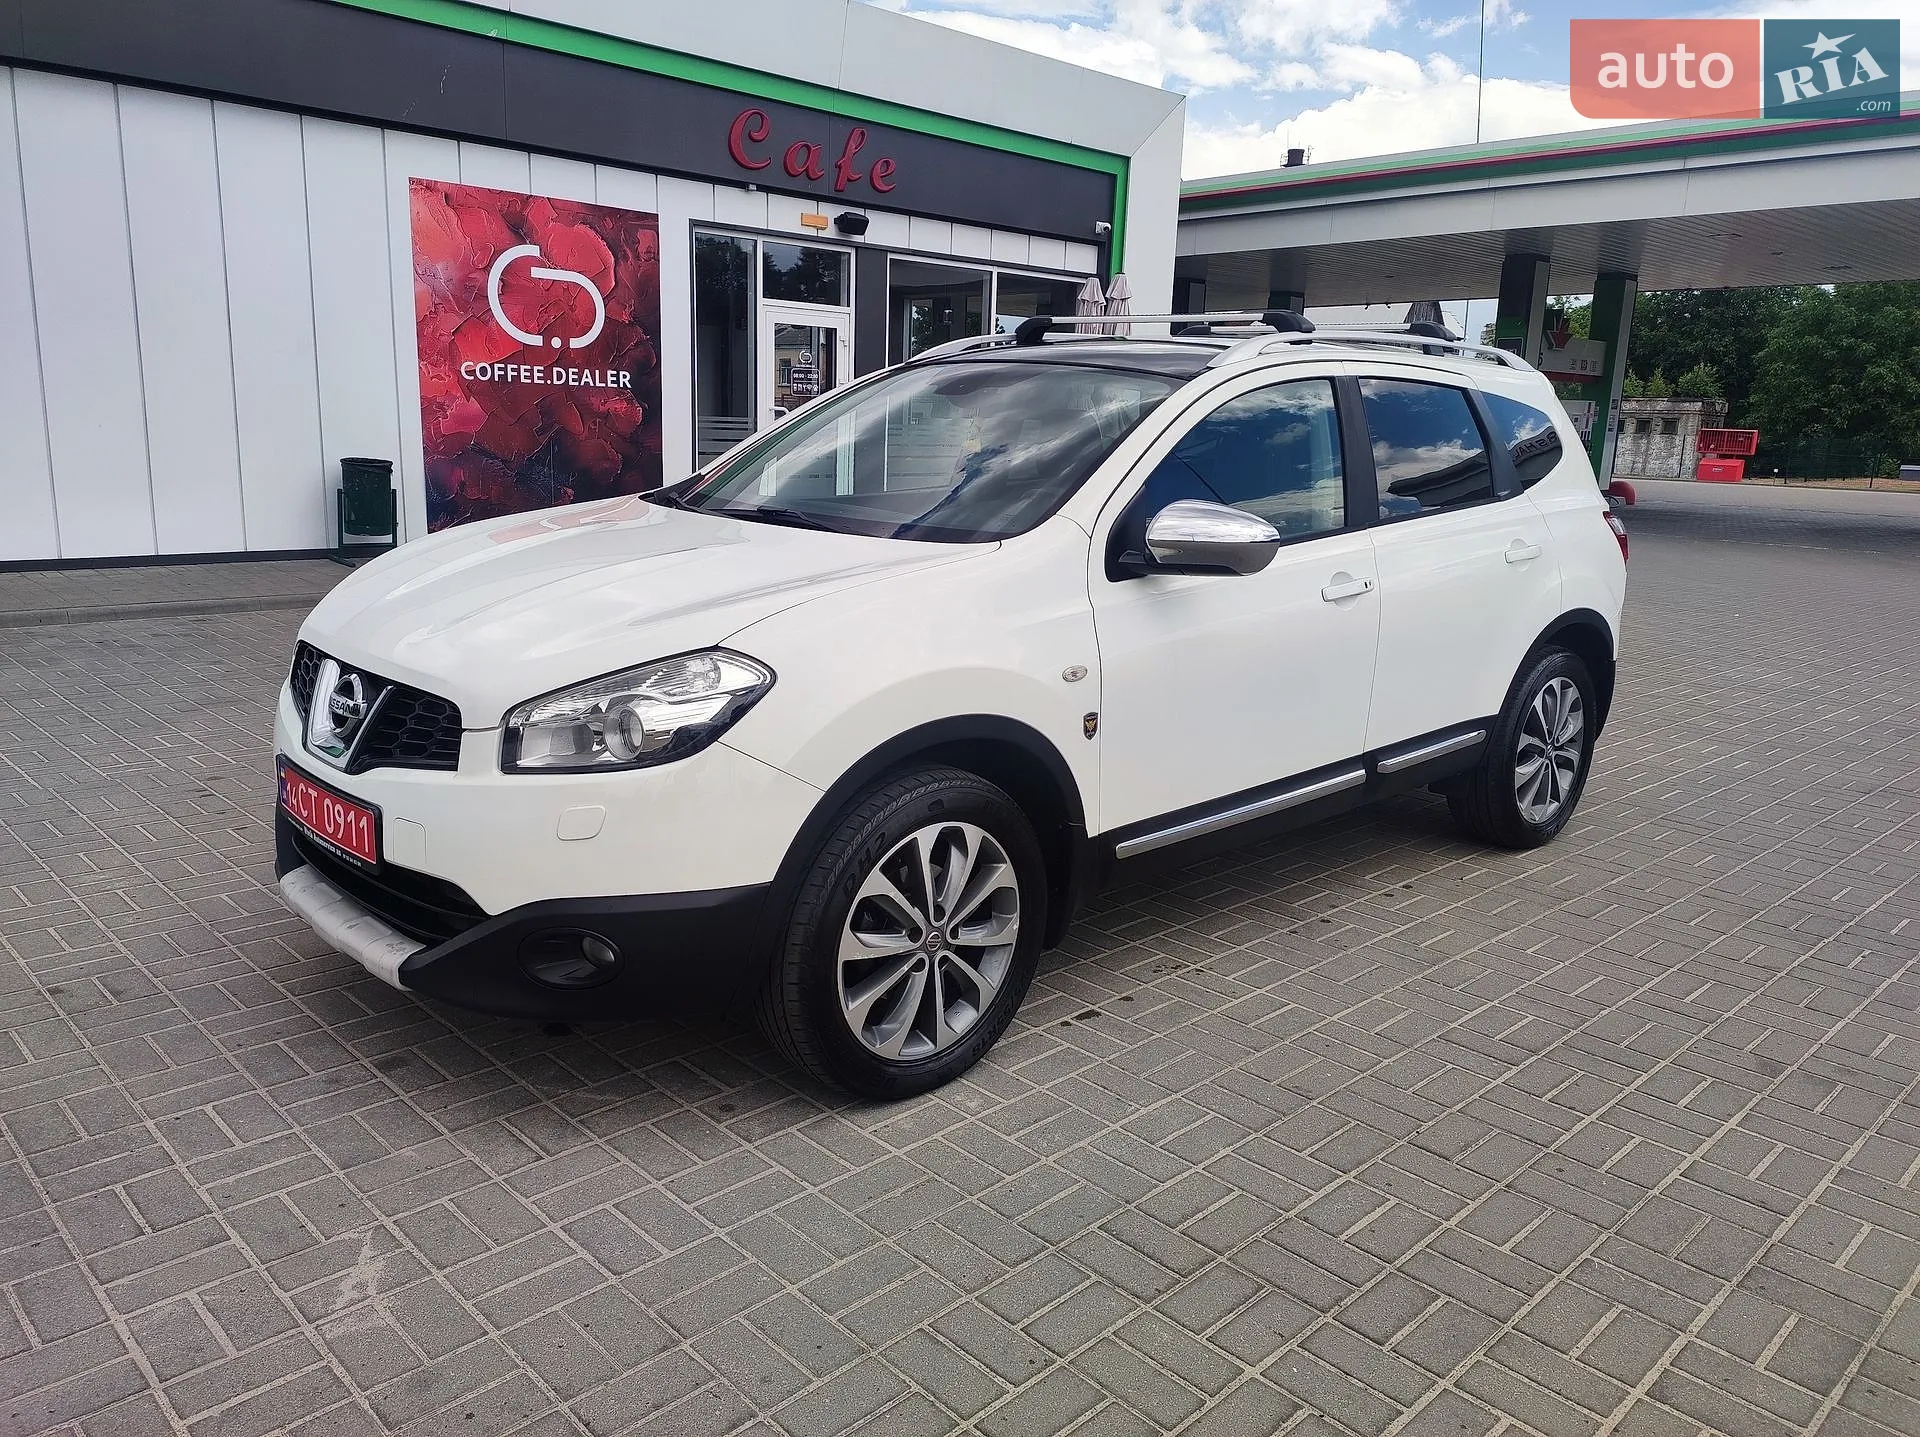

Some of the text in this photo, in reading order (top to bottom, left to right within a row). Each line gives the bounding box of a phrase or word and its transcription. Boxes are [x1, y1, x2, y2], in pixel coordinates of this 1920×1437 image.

[728, 108, 897, 193] Cafe
[460, 361, 632, 388] COFFEE.DEALER
[323, 798, 369, 853] 0911
